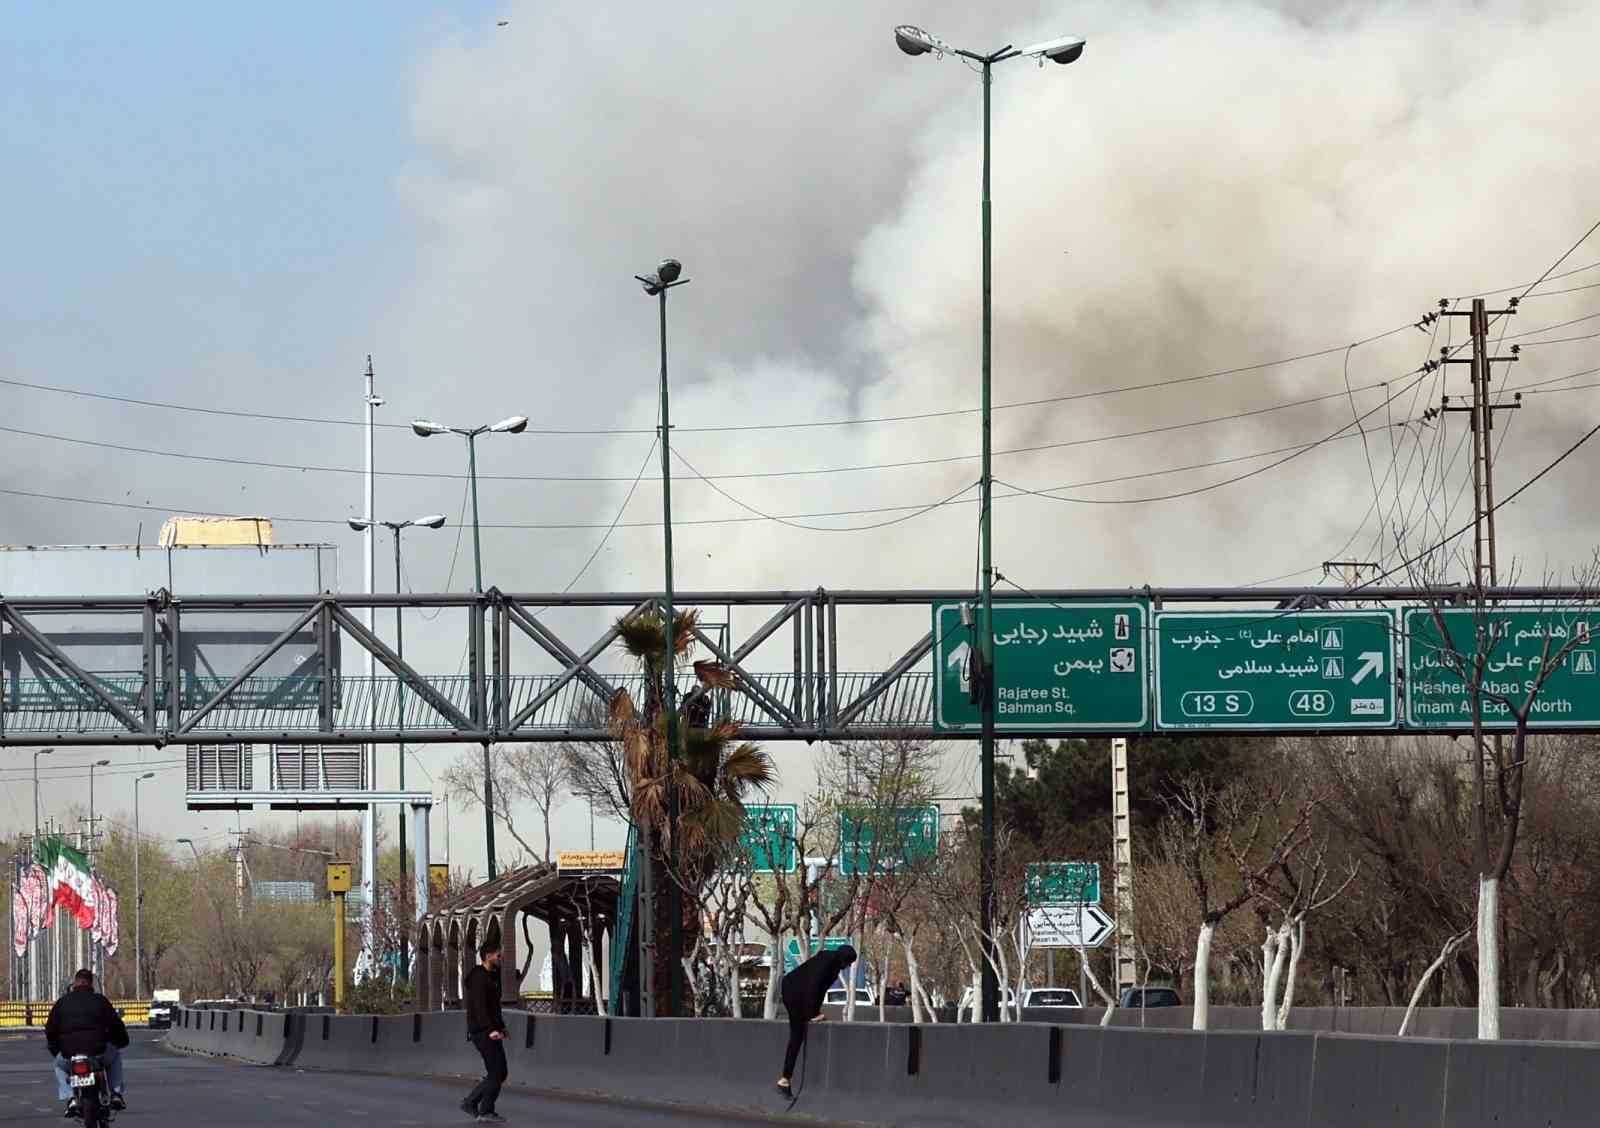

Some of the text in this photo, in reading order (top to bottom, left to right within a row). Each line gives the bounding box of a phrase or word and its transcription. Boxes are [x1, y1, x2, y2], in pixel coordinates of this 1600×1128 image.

[993, 619, 1103, 645] شهید رجایی
[1171, 630, 1221, 650] جنوب
[1287, 628, 1319, 651] امام
[1054, 656, 1104, 676] بهمن
[1218, 655, 1319, 679] شهید سلامی
[998, 687, 1070, 701] Raja'ee St.
[1193, 694, 1240, 713] 13 S
[1296, 693, 1326, 712] 48
[998, 702, 1077, 716] Bahman Sq.
[1413, 701, 1455, 714] Imam
[1530, 698, 1572, 713] North
